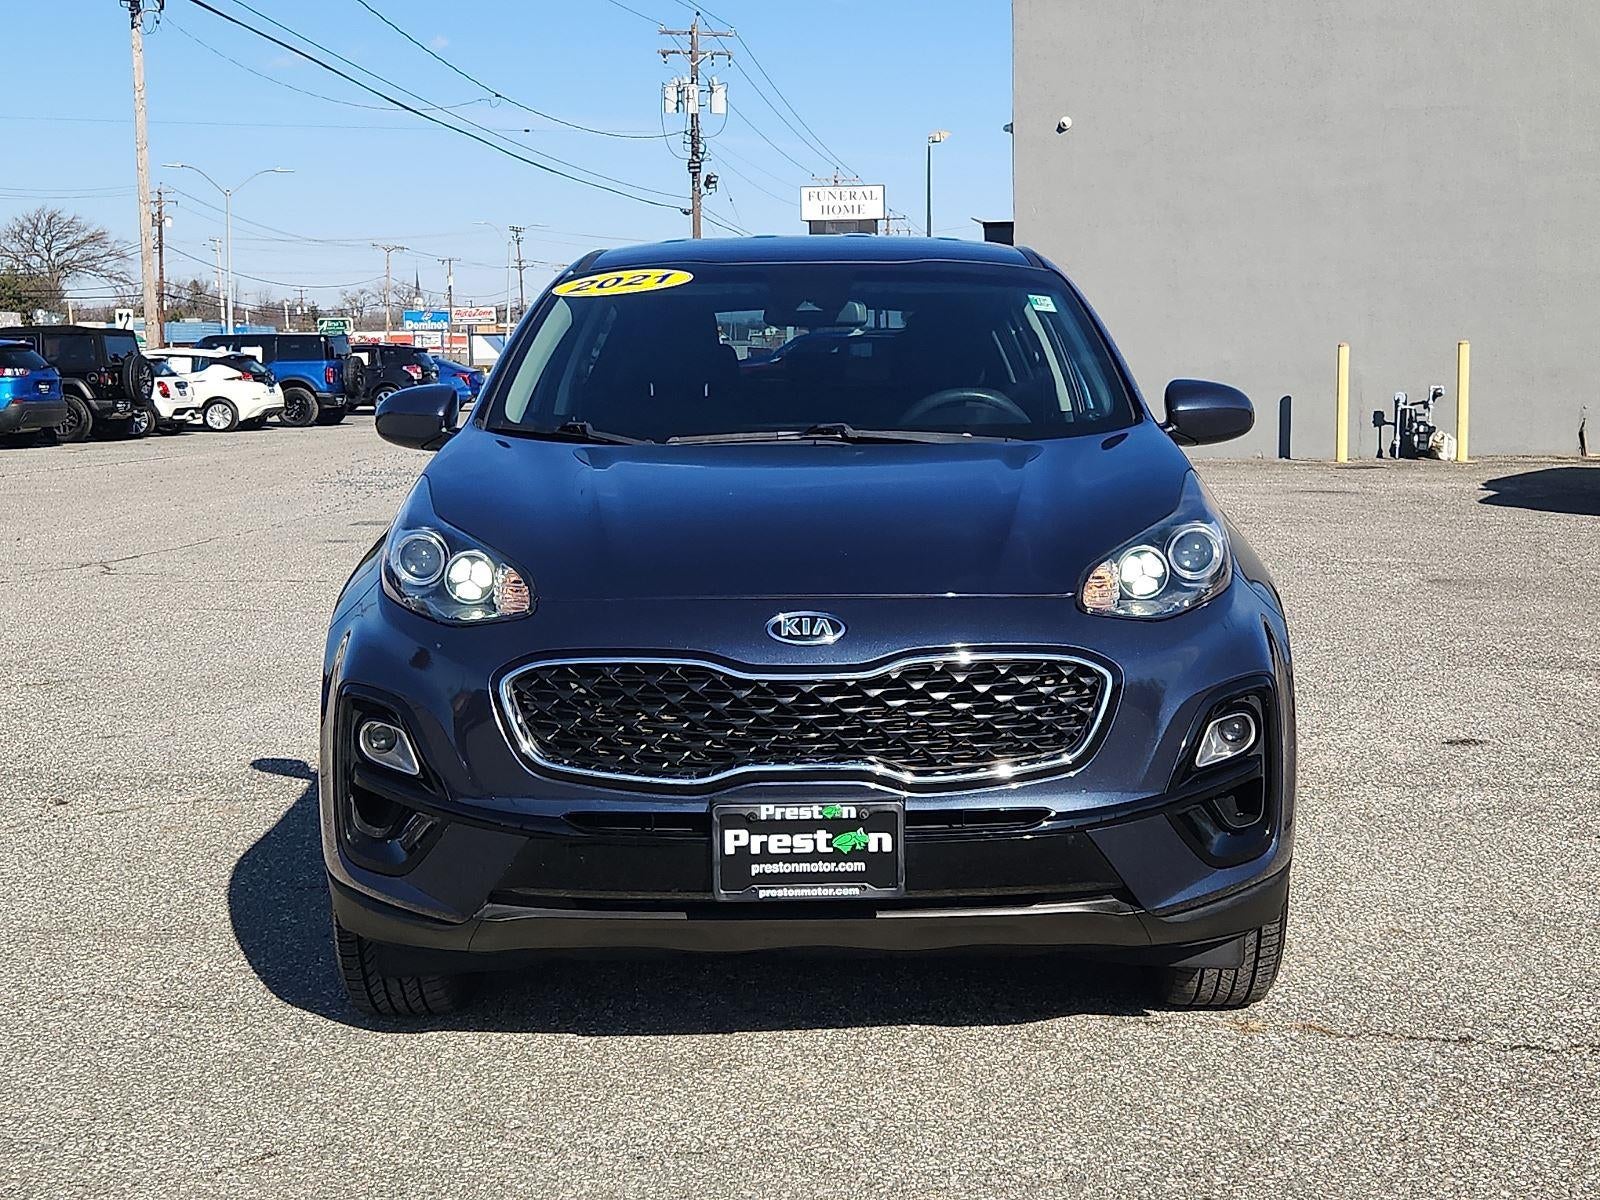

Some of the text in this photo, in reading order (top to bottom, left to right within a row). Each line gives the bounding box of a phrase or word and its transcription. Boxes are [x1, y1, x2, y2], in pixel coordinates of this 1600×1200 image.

[808, 190, 878, 201] FUNERAL
[821, 204, 866, 215] HOME
[567, 273, 675, 293] 2021
[454, 308, 493, 318] AutoZone
[405, 320, 448, 330] Domino's
[780, 617, 834, 636] KIA
[751, 861, 866, 876] prestonmotor.com
[758, 886, 860, 898] prestonmotor.com
